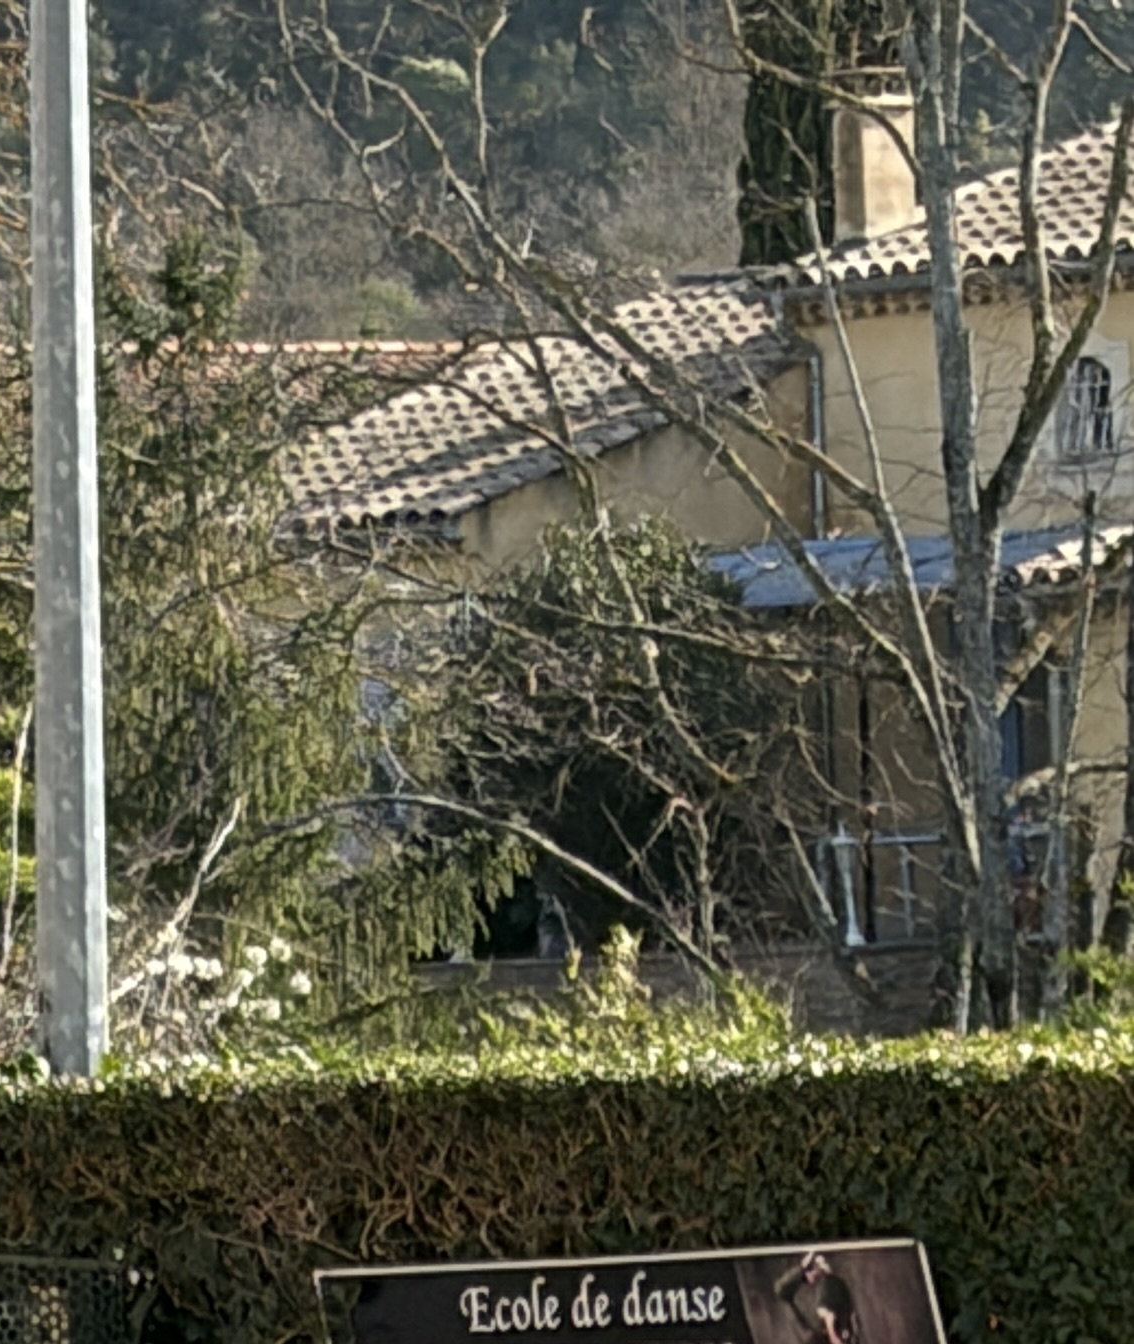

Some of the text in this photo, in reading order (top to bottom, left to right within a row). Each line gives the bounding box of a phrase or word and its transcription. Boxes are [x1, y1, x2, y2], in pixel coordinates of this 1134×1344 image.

[460, 1271, 726, 1333] Ecole de danse
